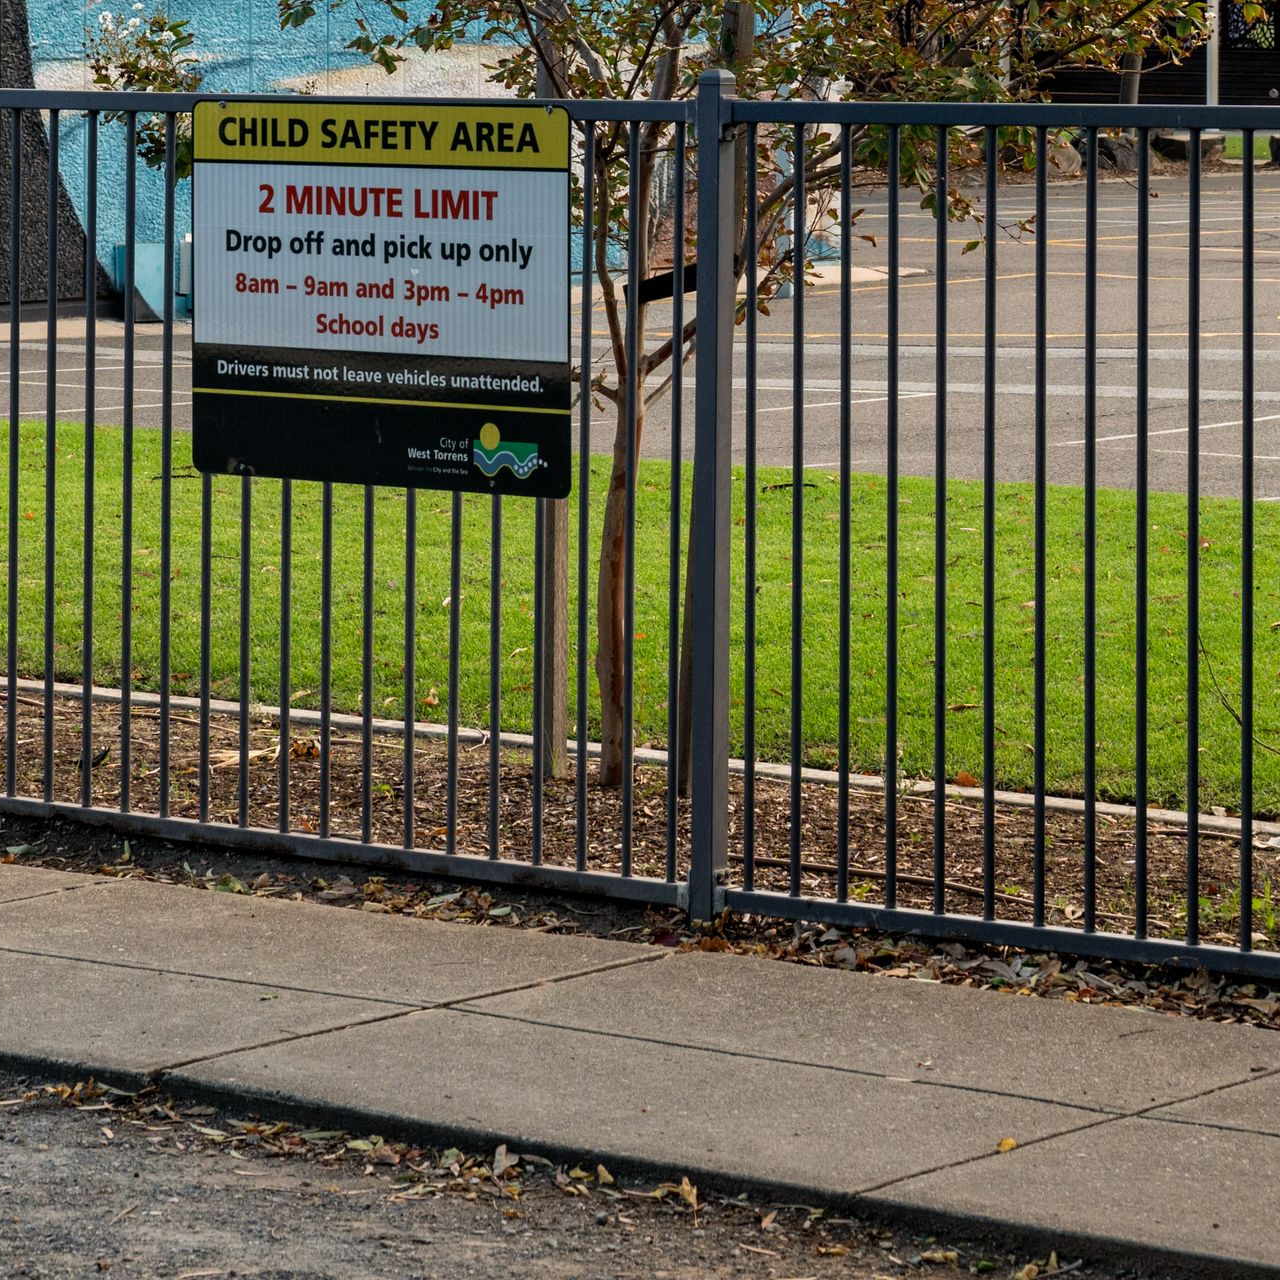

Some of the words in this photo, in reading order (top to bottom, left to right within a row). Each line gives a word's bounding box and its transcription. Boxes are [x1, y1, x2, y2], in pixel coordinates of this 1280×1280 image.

[219, 117, 309, 147] CHILD
[321, 119, 439, 151] SAFETY
[450, 122, 540, 153] AREA
[258, 184, 275, 213] 2
[286, 185, 403, 218] MINUTE
[414, 189, 499, 221] LIMIT
[225, 230, 282, 259] Drop
[290, 230, 324, 256] off
[332, 233, 376, 258] and
[384, 235, 432, 264] pick
[441, 241, 472, 266] up
[479, 238, 533, 270] only
[235, 272, 279, 294] 8am
[303, 275, 348, 297] 9am
[356, 276, 395, 299] and
[403, 279, 450, 306] 3pm
[475, 282, 525, 309] 4pm
[316, 313, 384, 337] School
[391, 316, 440, 344] days
[217, 359, 269, 378] Drivers
[272, 364, 310, 380] must
[313, 366, 339, 381] not
[342, 366, 382, 384] leave
[386, 369, 447, 388] vehicles
[450, 373, 544, 393] unattended.
[407, 448, 430, 459] West
[434, 449, 468, 462] Torrens
[439, 437, 456, 451] City
[459, 438, 469, 449] of
